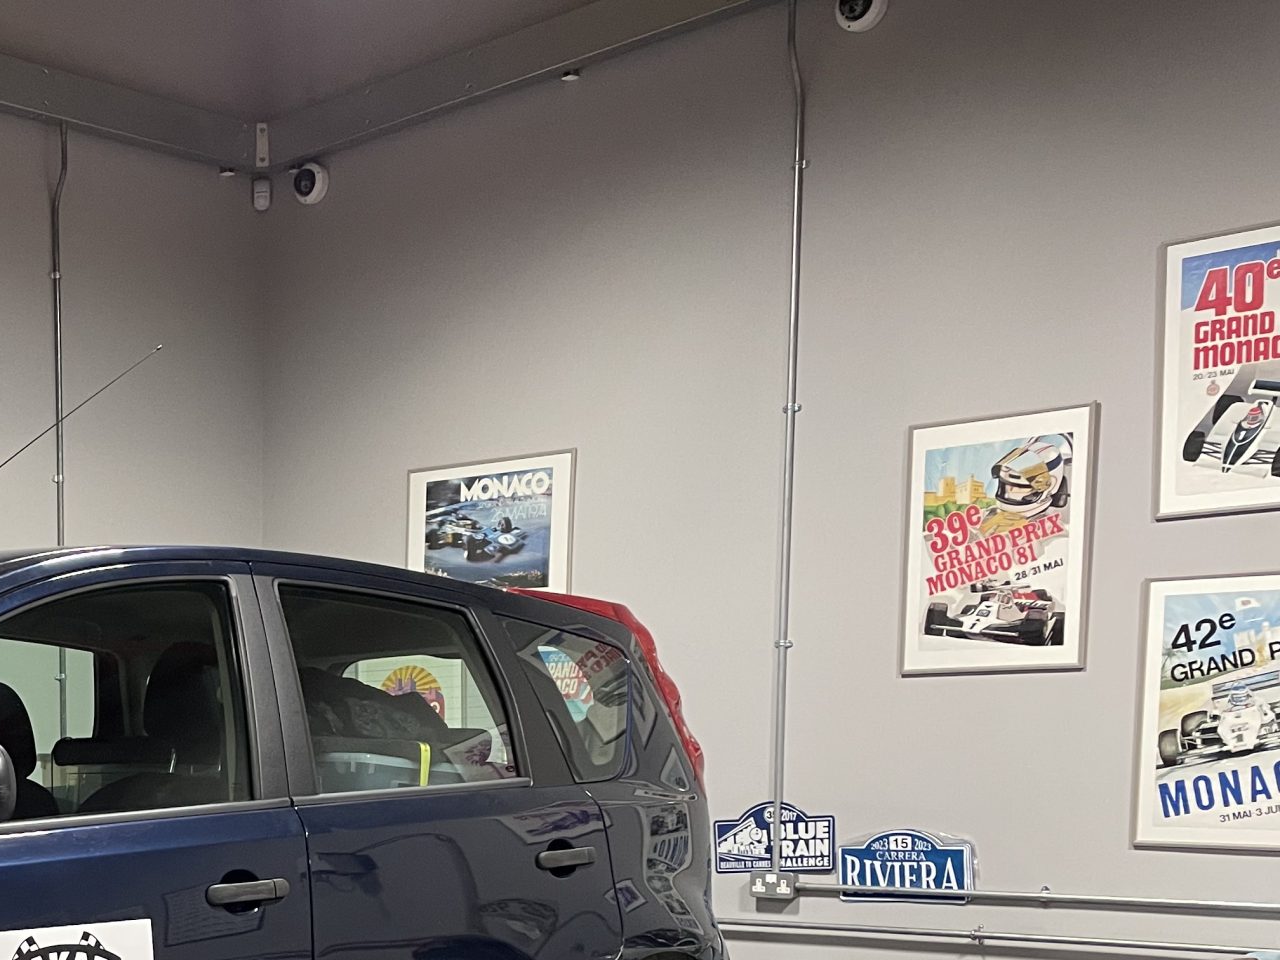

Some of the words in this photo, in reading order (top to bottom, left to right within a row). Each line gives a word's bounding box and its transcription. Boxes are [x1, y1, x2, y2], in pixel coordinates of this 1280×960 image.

[1194, 310, 1275, 344] GRAND
[460, 472, 550, 502] MONACO
[926, 504, 982, 553] 39e
[934, 534, 1007, 573] GRAND
[1008, 513, 1064, 548] PRIX
[926, 552, 1013, 596] MONACO
[1016, 543, 1038, 565] 81
[1043, 558, 1064, 572] MAI
[1171, 612, 1236, 653] 42e
[1170, 648, 1256, 682] GRAND
[781, 810, 797, 821] 2017
[771, 839, 829, 857] RAIN
[870, 838, 889, 850] 2023
[893, 837, 908, 849] 15
[914, 838, 932, 851] 2023
[876, 851, 926, 861] CARRERA
[780, 857, 829, 867] HALLENGE
[844, 853, 959, 890] RIVIERA
